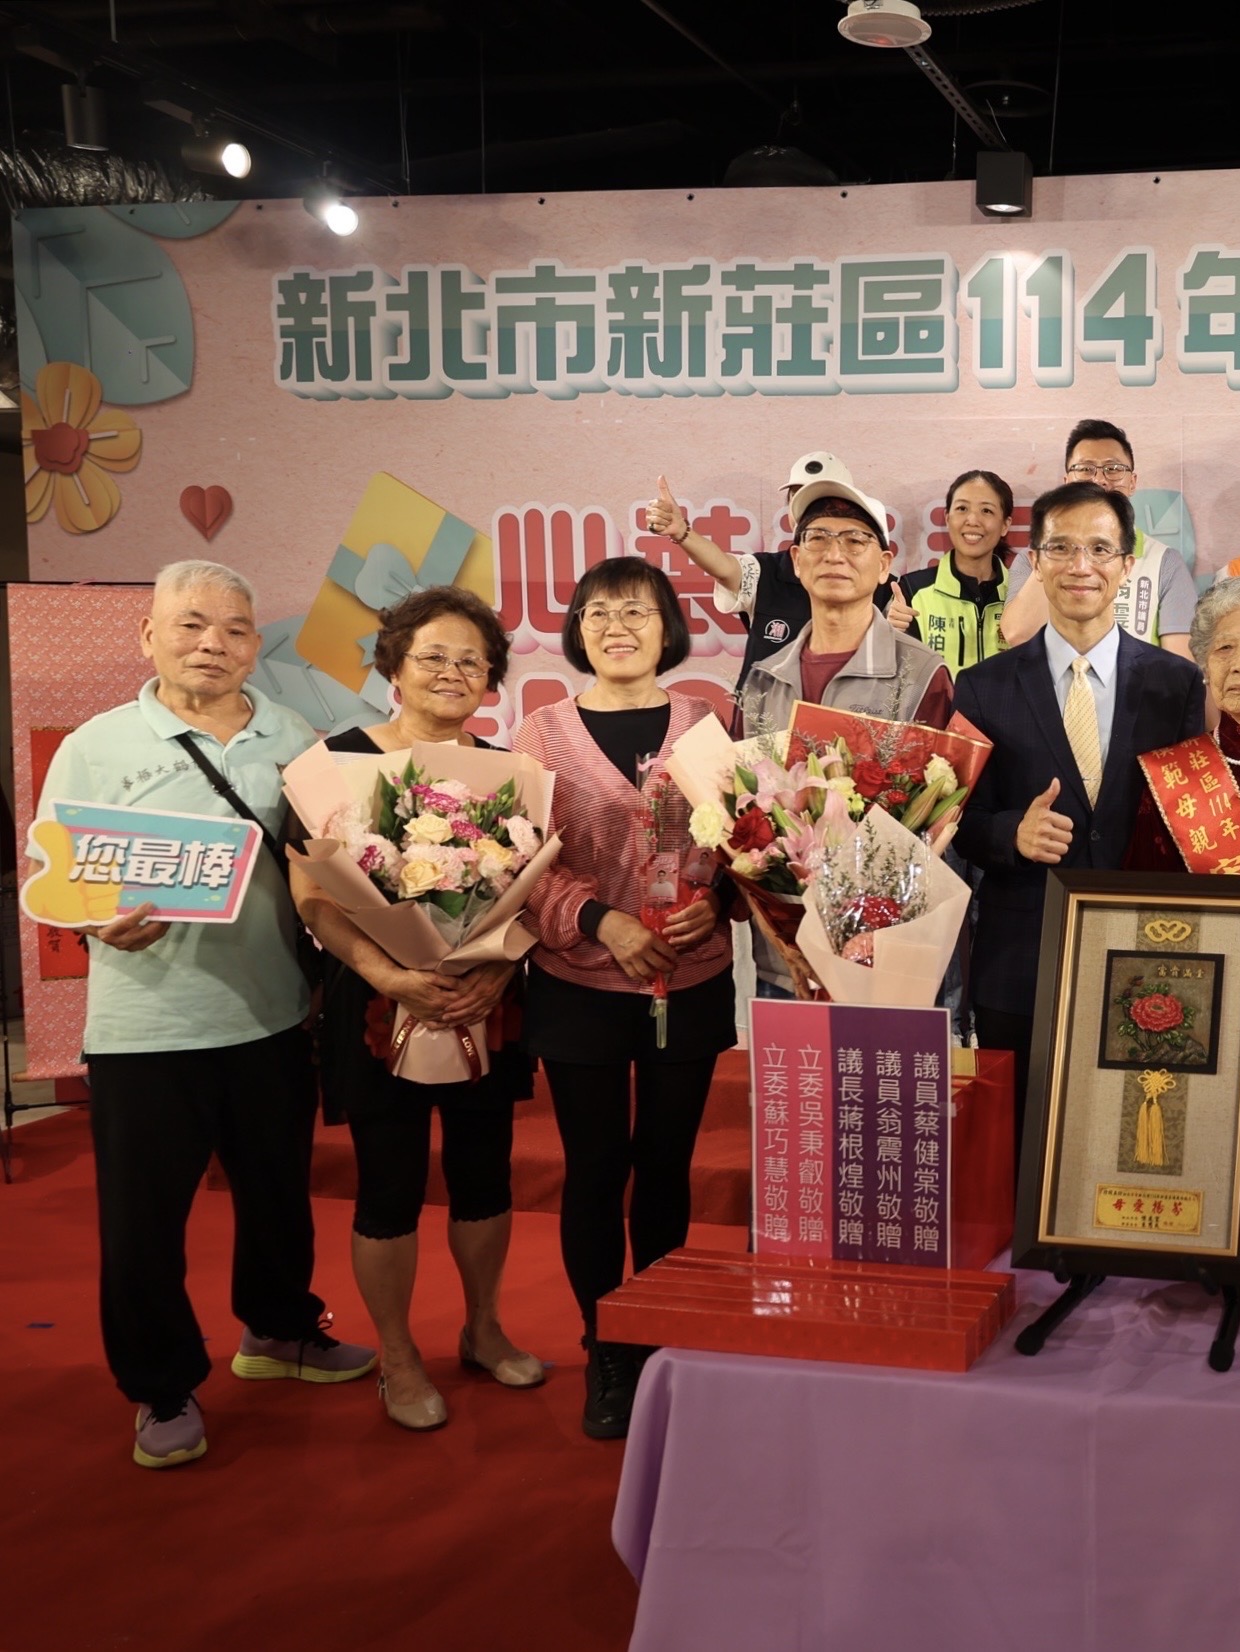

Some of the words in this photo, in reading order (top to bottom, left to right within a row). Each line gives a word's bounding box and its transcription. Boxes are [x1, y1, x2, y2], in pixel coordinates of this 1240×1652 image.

[928, 614, 946, 658] 陳柏
[1137, 580, 1149, 631] 新北市議員
[69, 834, 237, 890] 您最棒
[461, 1036, 475, 1057] LOVE
[763, 1042, 789, 1242] 立委蘇巧慧敬贈
[797, 1043, 825, 1243] 立委吳秉叡敬贈
[837, 1046, 864, 1247] 議長蔣根煌敬贈
[876, 1048, 903, 1249] 議員翁震州敬贈
[913, 1051, 940, 1252] 議員蔡健棠敬贈
